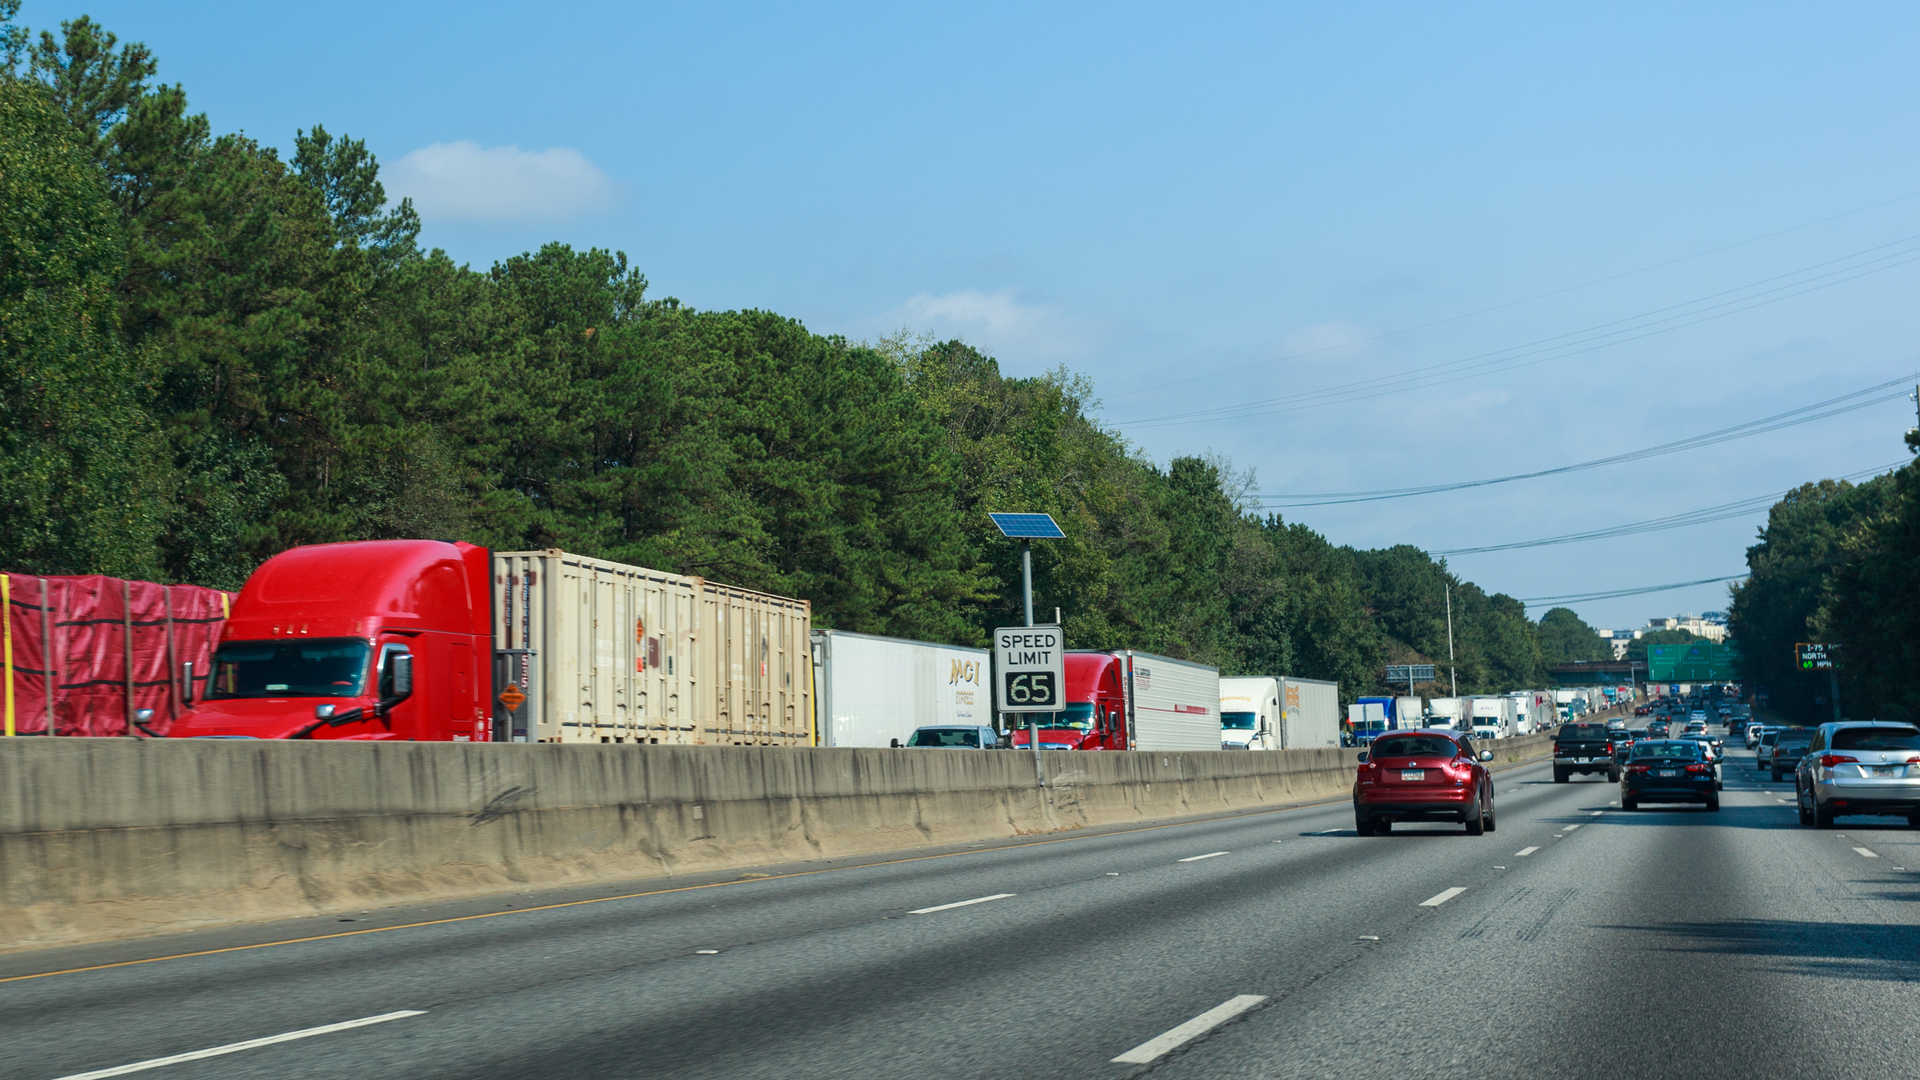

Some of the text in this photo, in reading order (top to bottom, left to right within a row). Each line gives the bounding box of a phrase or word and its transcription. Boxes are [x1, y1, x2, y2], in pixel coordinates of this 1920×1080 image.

[1001, 634, 1056, 649] SPEED
[1008, 651, 1051, 665] LIMIT
[1802, 652, 1827, 660] NORTH
[1803, 660, 1813, 669] 65
[1816, 660, 1832, 668] MPH
[949, 658, 980, 687] MCI
[1010, 674, 1050, 703] 65
[1219, 695, 1251, 703] WERNER
